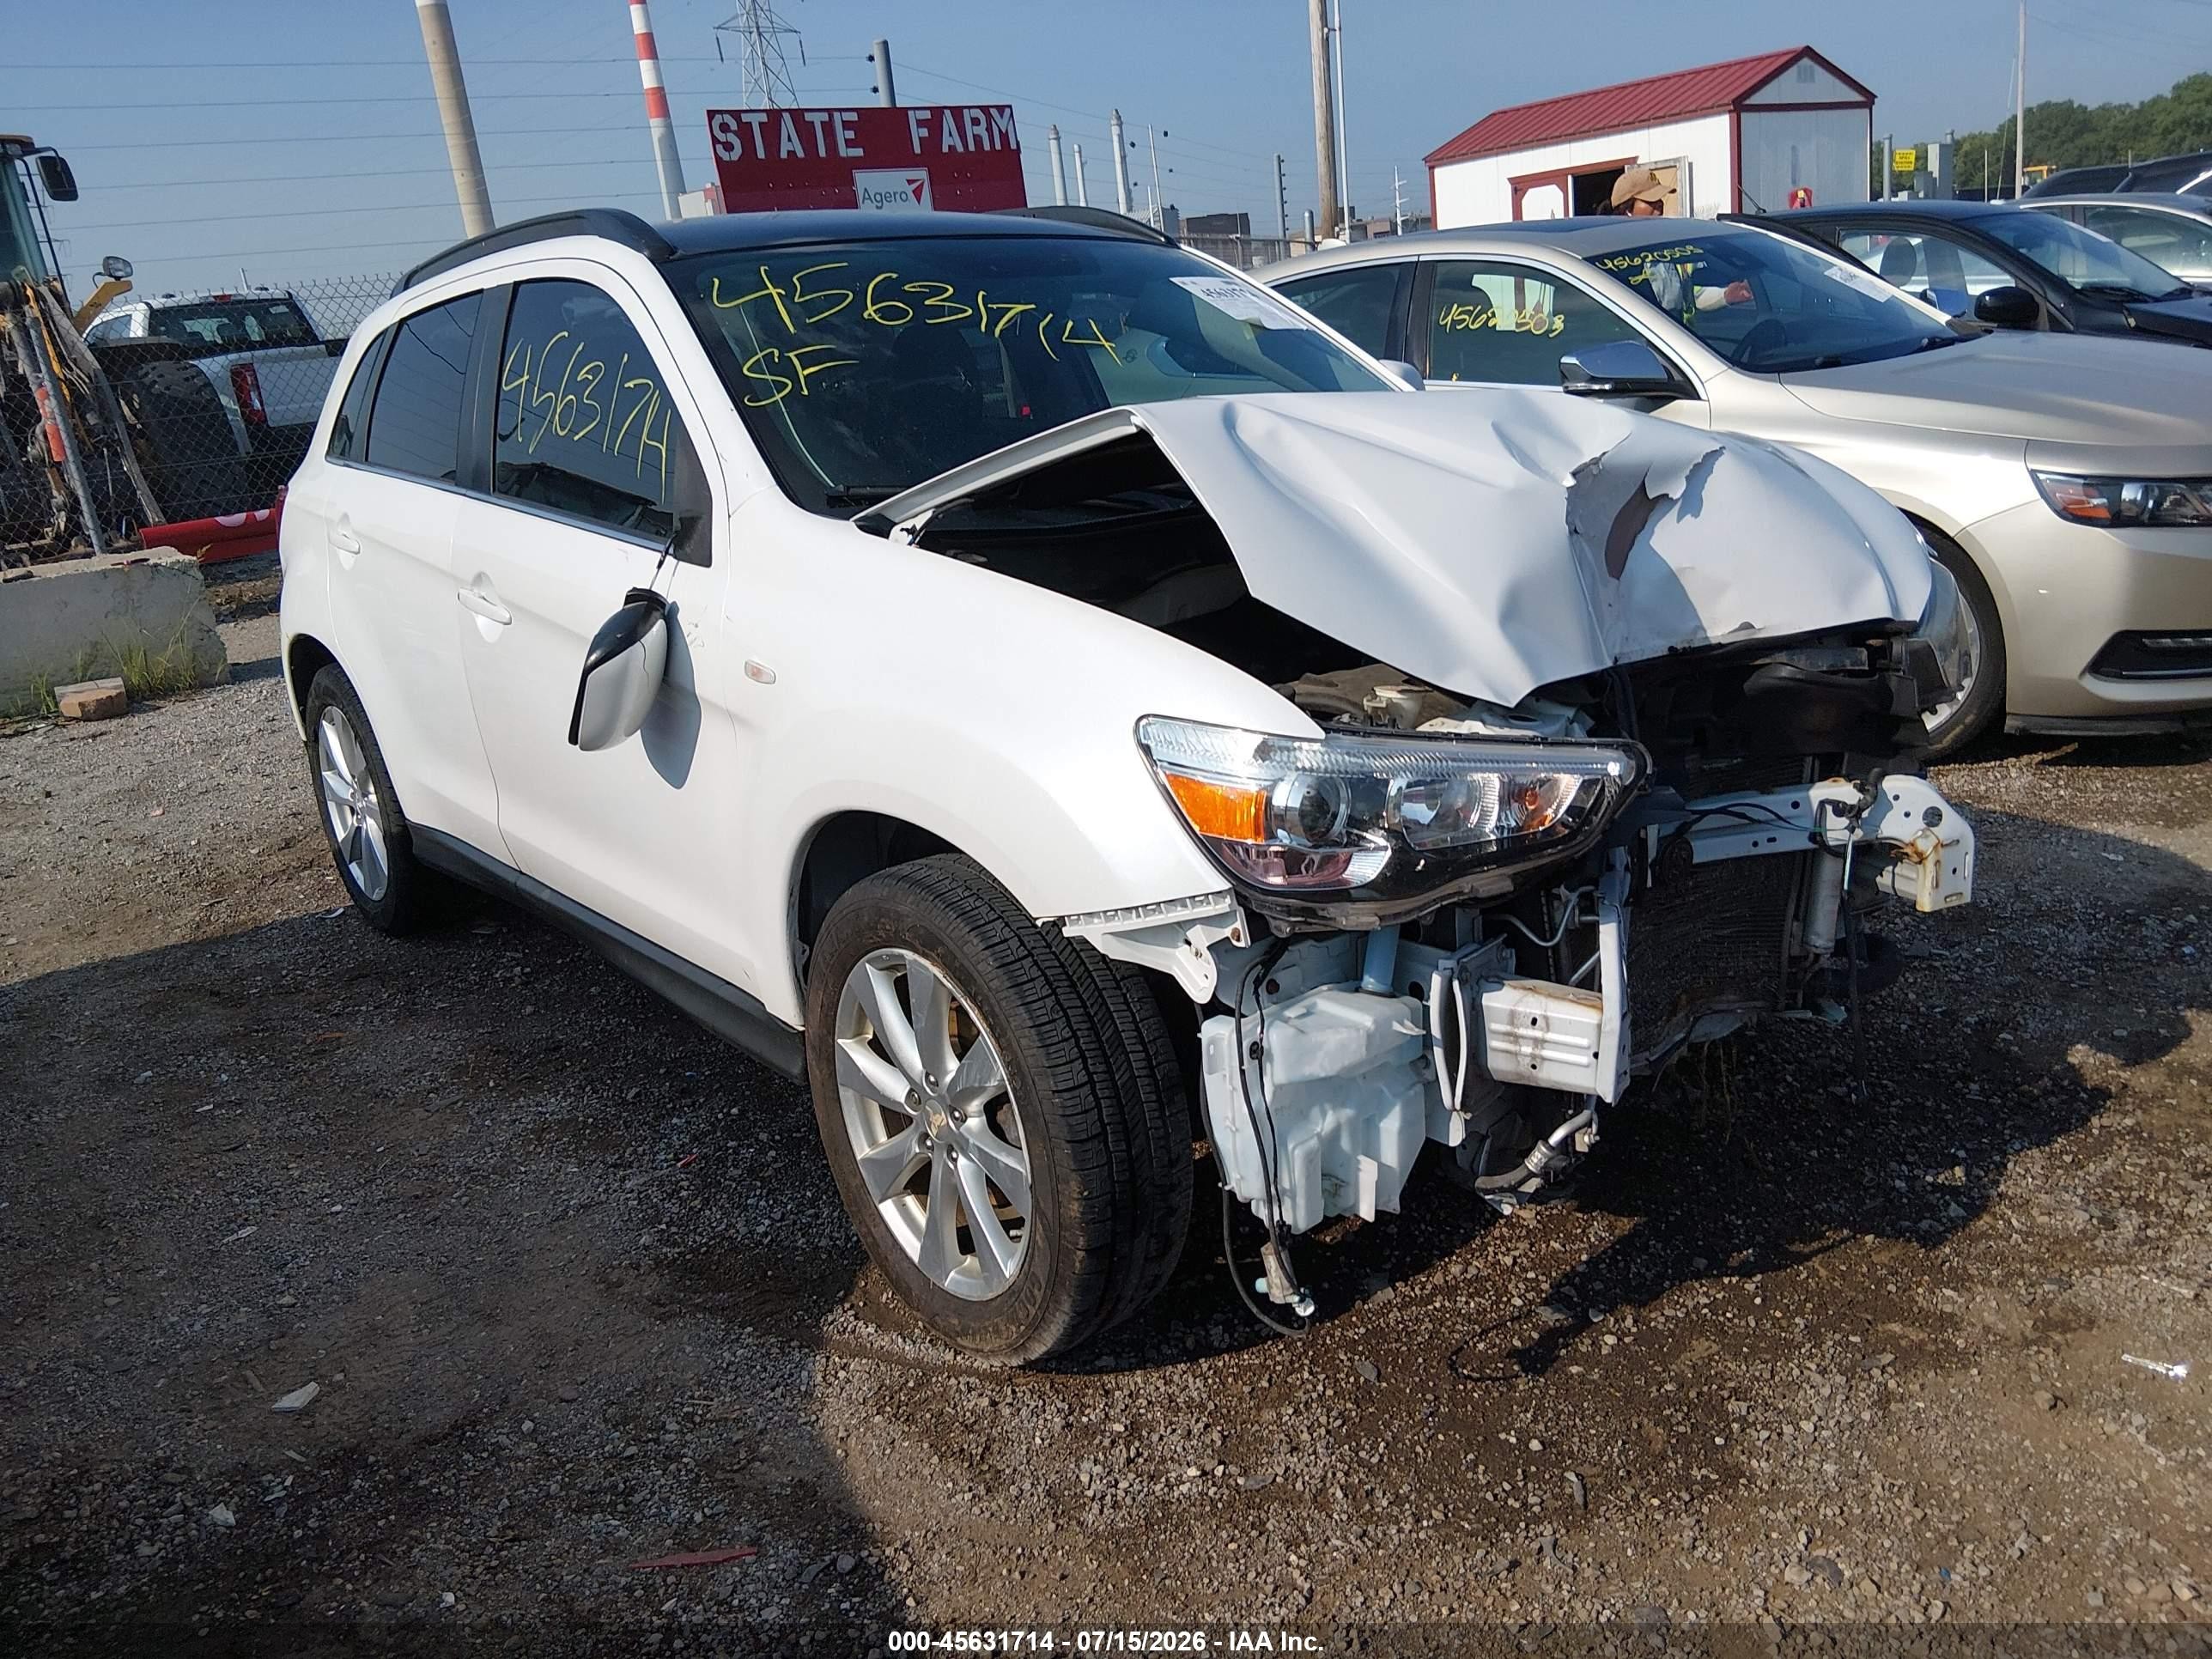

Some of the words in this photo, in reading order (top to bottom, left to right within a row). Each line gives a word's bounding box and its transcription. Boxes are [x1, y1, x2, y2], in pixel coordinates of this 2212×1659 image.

[711, 111, 864, 161] STATE
[907, 107, 1018, 155] FARM
[861, 187, 908, 211] Agero
[712, 263, 1123, 367] 45631714
[741, 345, 860, 407] SF
[502, 331, 672, 505] 45631714
